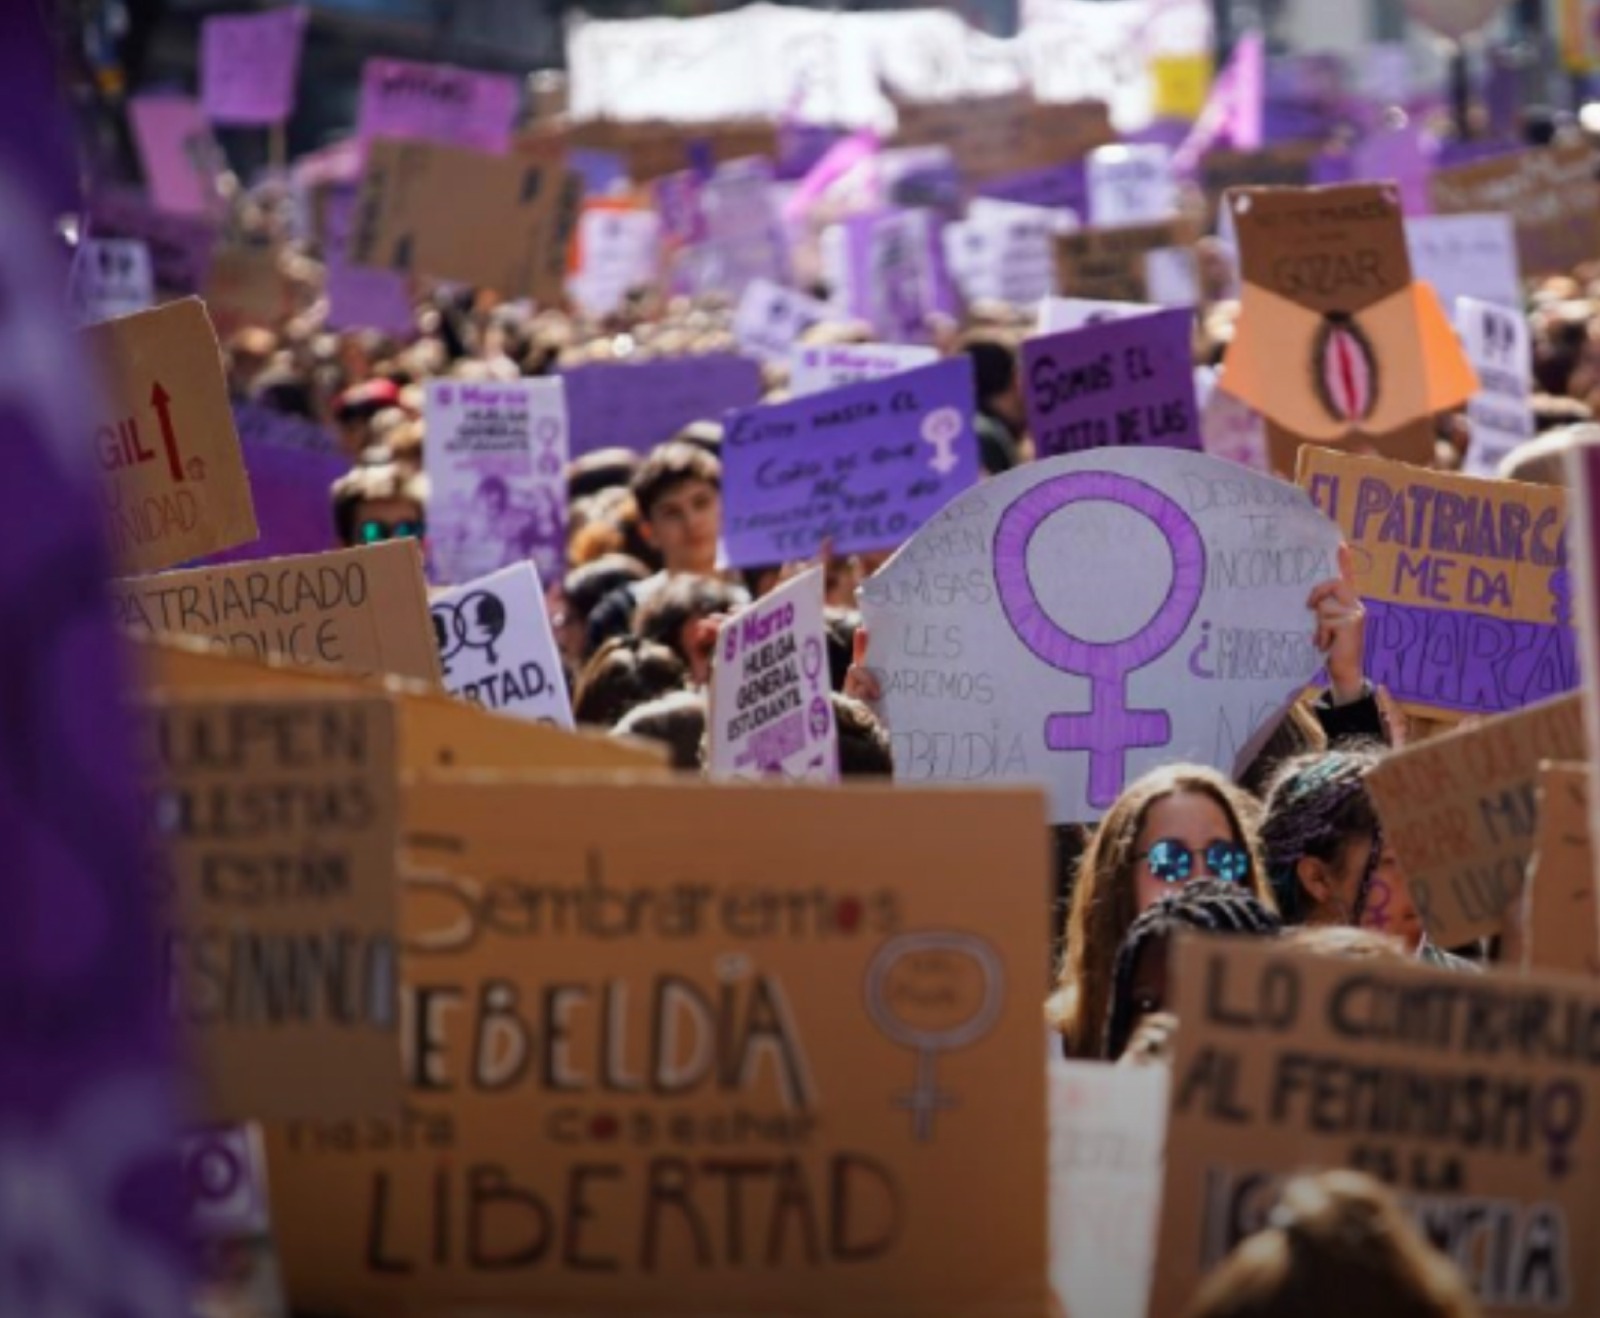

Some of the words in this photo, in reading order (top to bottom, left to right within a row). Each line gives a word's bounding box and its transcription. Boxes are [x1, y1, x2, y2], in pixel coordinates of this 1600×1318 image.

[1392, 551, 1457, 603] ME
[1466, 564, 1513, 608] DA
[741, 601, 795, 652] Marzo
[903, 624, 963, 659] LES
[742, 630, 797, 680] HUELGA
[736, 658, 799, 711] GENERAL
[1202, 952, 1305, 1032] LO
[1175, 1042, 1253, 1124] AL
[364, 1147, 908, 1276] LIBERTAD
